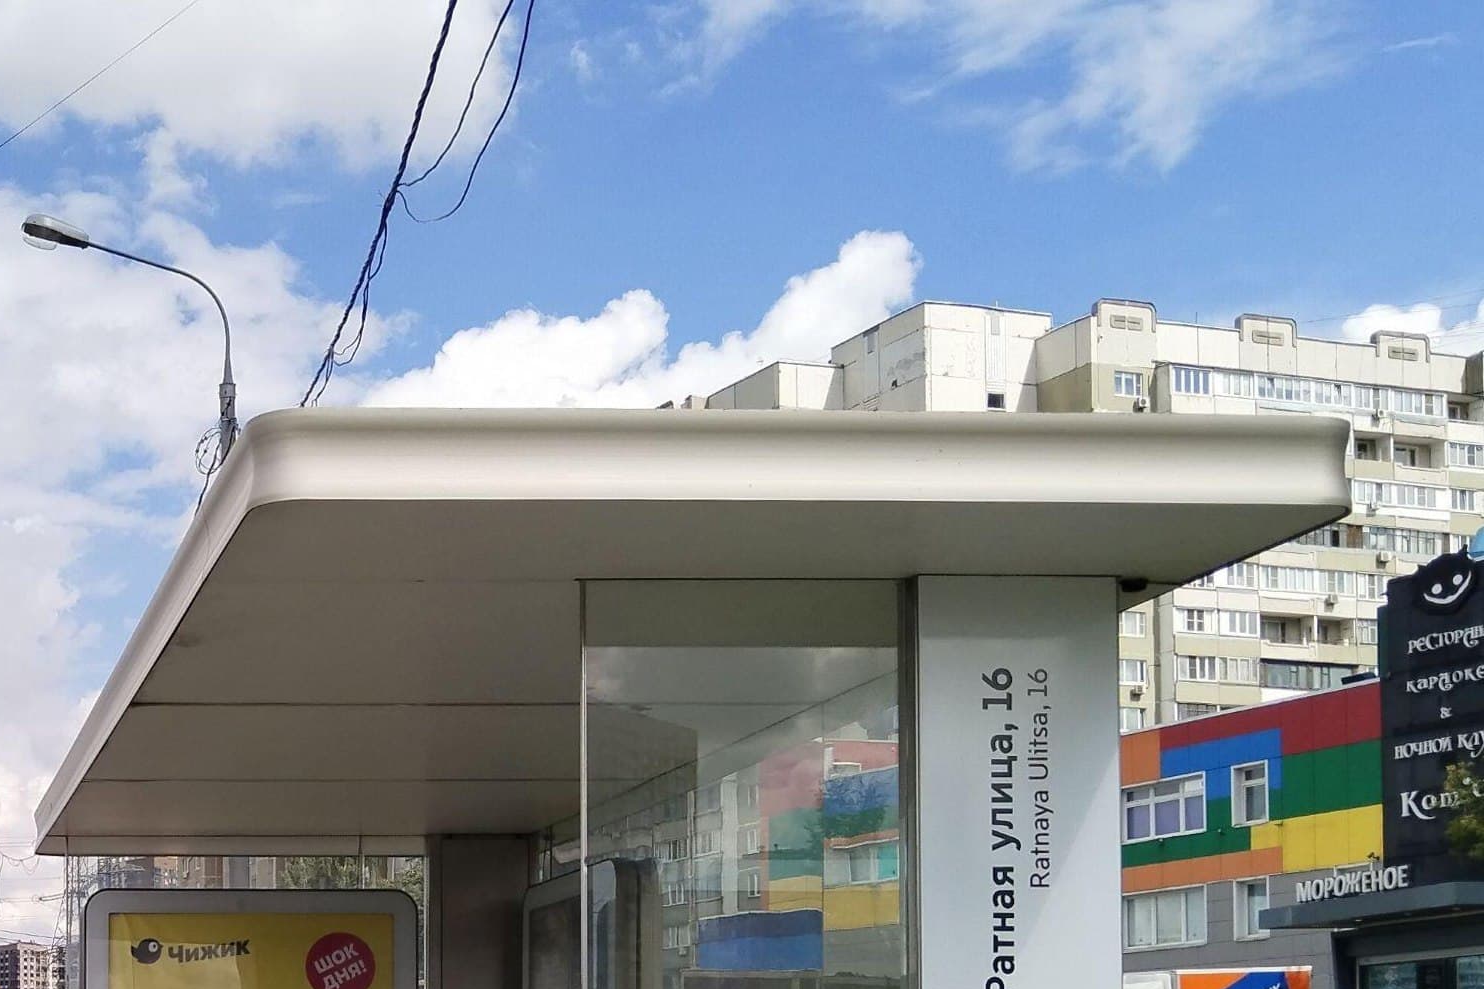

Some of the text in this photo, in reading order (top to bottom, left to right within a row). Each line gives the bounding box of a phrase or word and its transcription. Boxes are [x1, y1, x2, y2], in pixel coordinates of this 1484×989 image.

[982, 667, 1013, 712] 16
[1440, 707, 1453, 719] &
[990, 723, 1021, 851] улица,
[1028, 668, 1054, 888] Ratnaya Ulitsa, 16
[1296, 865, 1409, 902] МОРОЖЕНОЕ
[314, 943, 359, 974] ШОК
